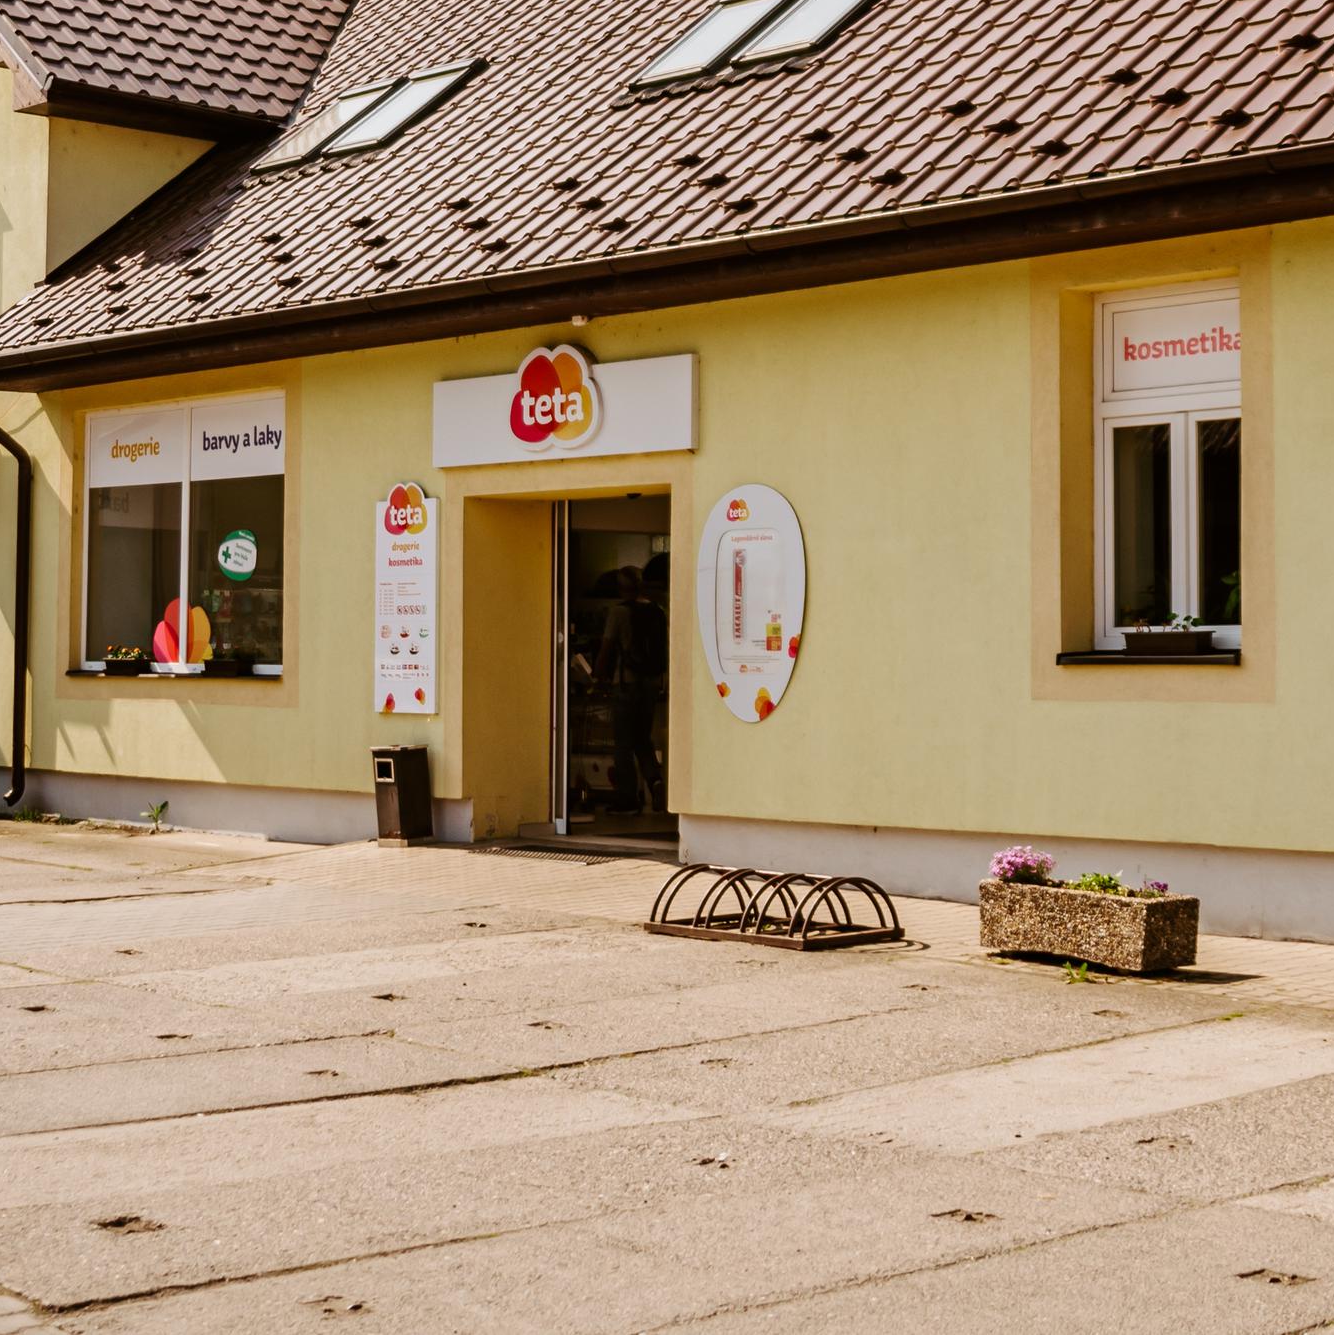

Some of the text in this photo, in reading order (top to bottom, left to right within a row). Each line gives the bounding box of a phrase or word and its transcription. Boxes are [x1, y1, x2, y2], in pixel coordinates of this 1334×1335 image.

[1123, 326, 1242, 362] kosmetika
[521, 387, 584, 426] teta
[111, 437, 160, 463] drogerie
[202, 424, 282, 453] barvy a laky
[389, 504, 423, 526] teta
[729, 507, 748, 518] teta
[391, 541, 420, 554] drogerie
[388, 557, 423, 567] kosmetika
